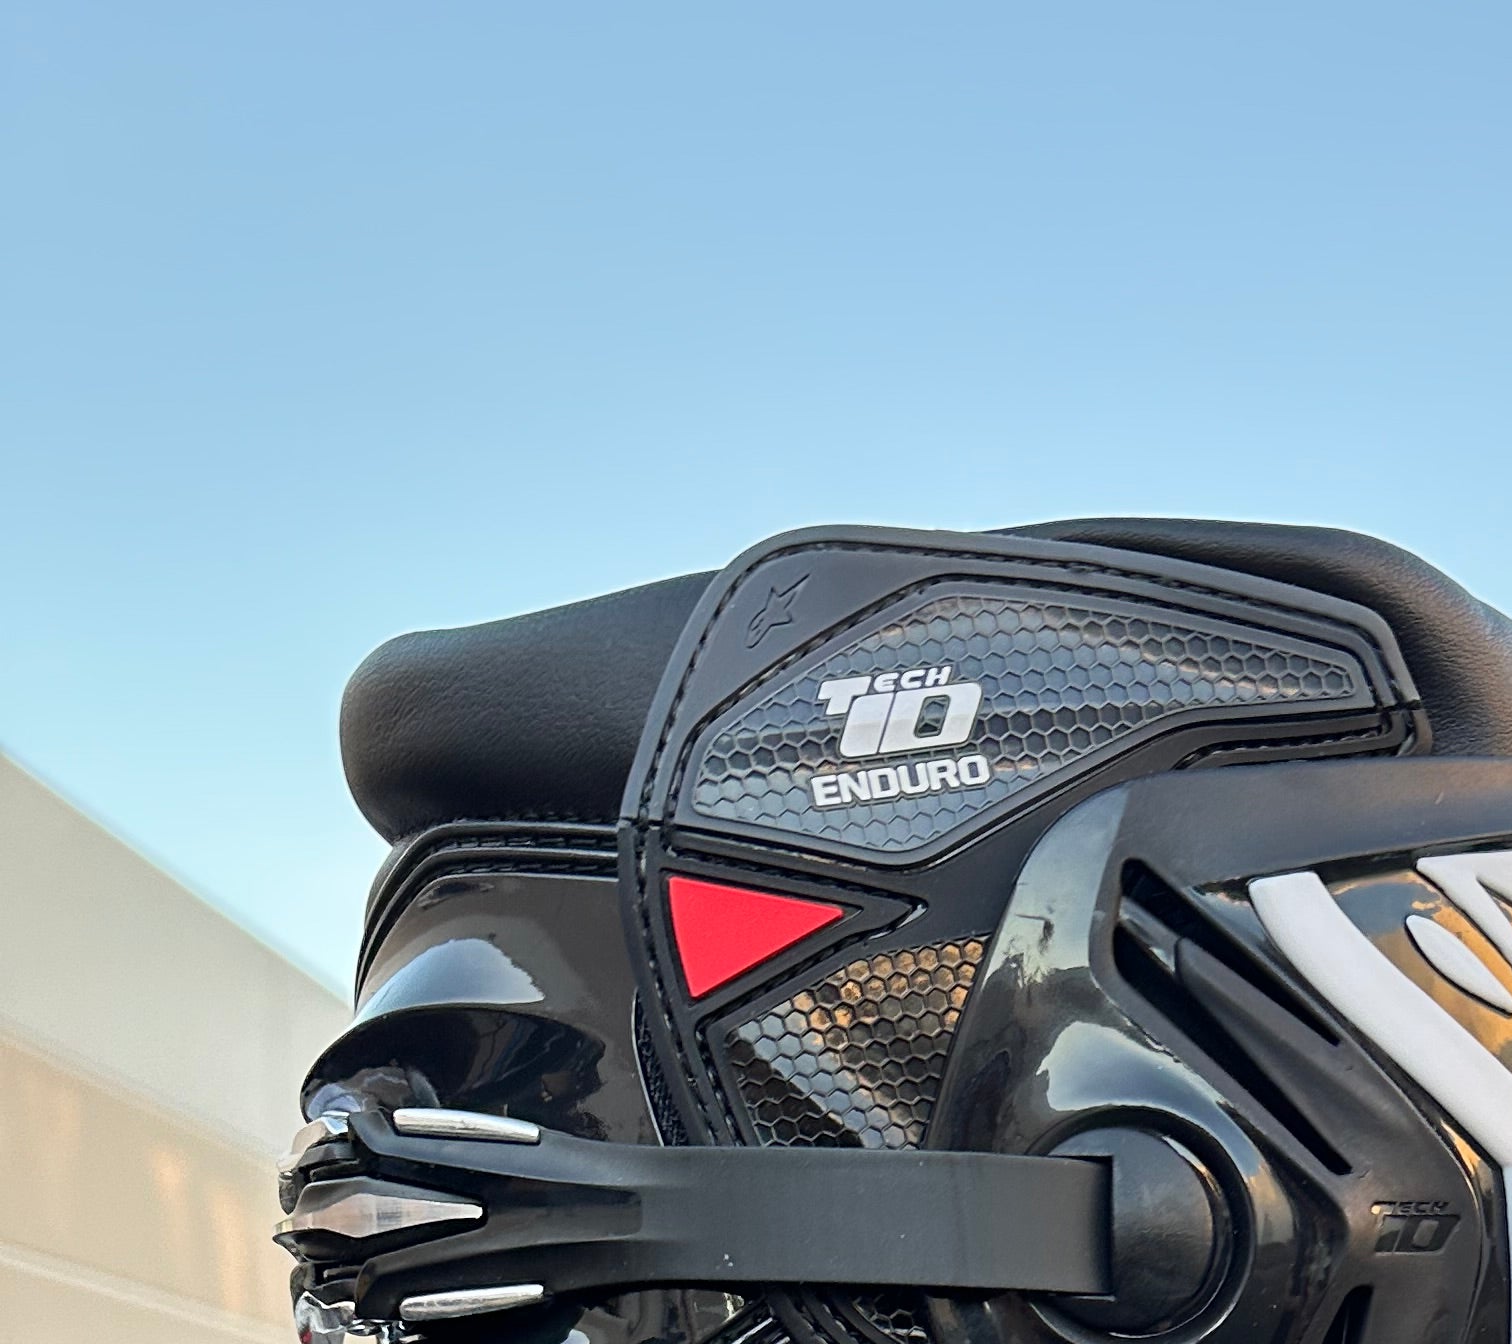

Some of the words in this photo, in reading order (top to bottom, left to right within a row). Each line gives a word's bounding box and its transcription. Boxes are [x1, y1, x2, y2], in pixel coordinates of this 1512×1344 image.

[817, 666, 951, 716] TECH
[840, 682, 982, 758] 10
[811, 755, 991, 807] ENDURO
[1374, 1214, 1461, 1253] 10
